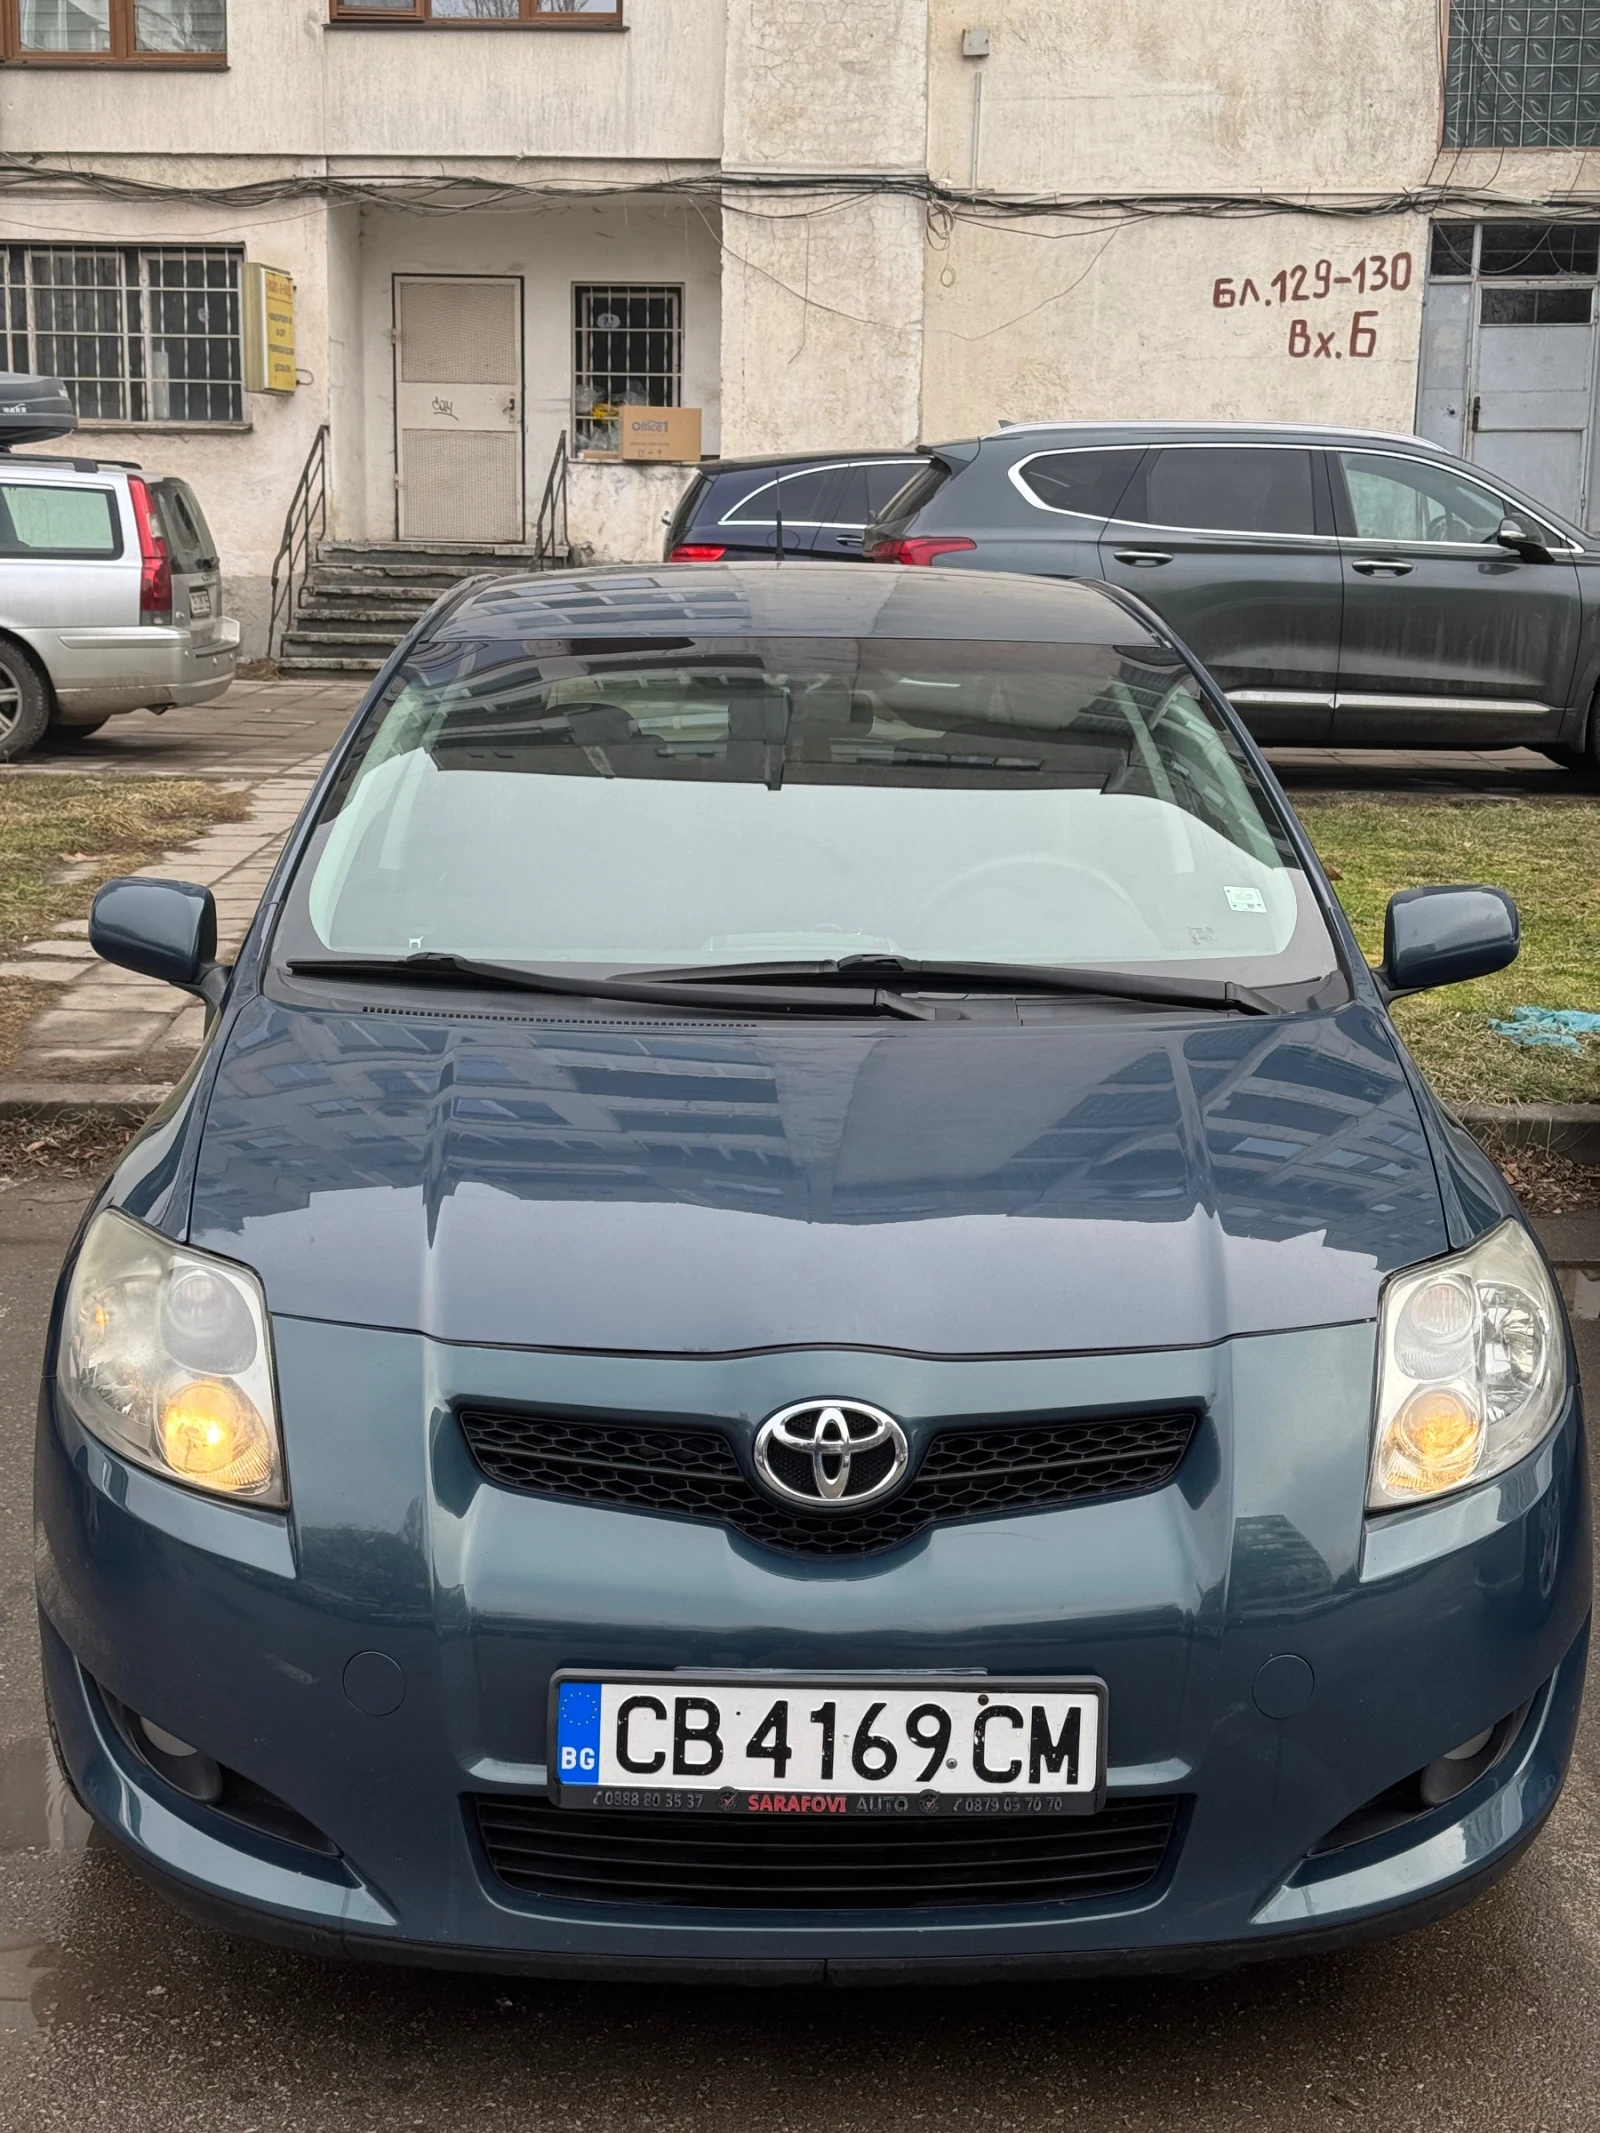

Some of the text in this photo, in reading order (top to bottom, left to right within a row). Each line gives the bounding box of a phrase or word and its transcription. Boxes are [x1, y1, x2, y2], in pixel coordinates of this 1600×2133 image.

[616, 1695, 1082, 1785] CB 4169 CM
[561, 1746, 596, 1770] BG
[604, 1791, 639, 1806] 0888
[643, 1793, 661, 1807] 80
[664, 1793, 682, 1808] 35
[686, 1794, 703, 1808] 37
[748, 1794, 847, 1812] SARAFOVI
[856, 1796, 909, 1812] AUTO
[965, 1797, 1000, 1812] 0879
[1024, 1797, 1041, 1812] 70
[1045, 1797, 1062, 1811] 70
